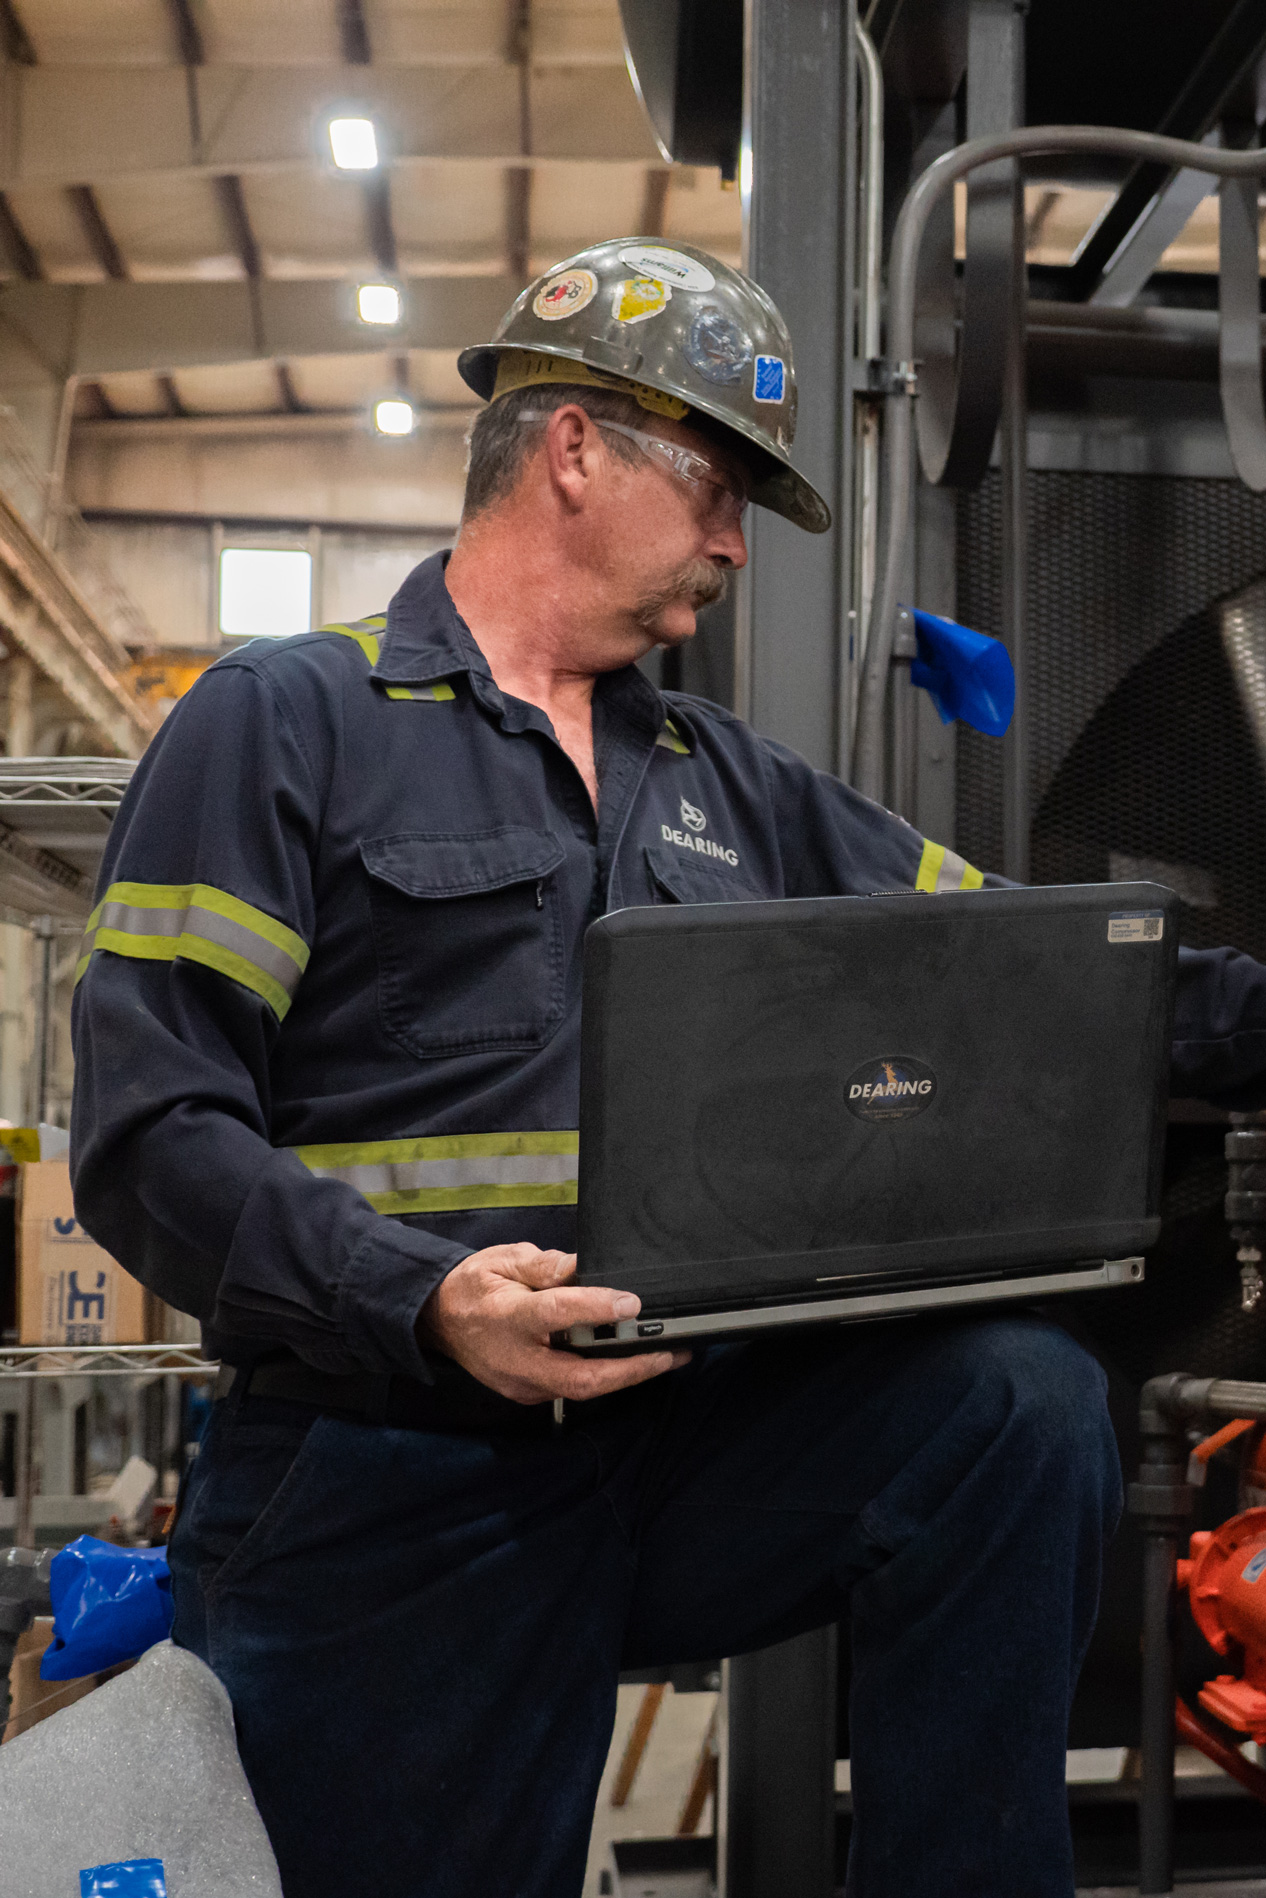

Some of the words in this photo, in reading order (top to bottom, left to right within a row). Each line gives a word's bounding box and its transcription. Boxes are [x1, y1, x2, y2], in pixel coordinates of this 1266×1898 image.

[641, 257, 686, 279] Williams
[661, 824, 739, 866] DEARING
[849, 1079, 932, 1099] DEARING
